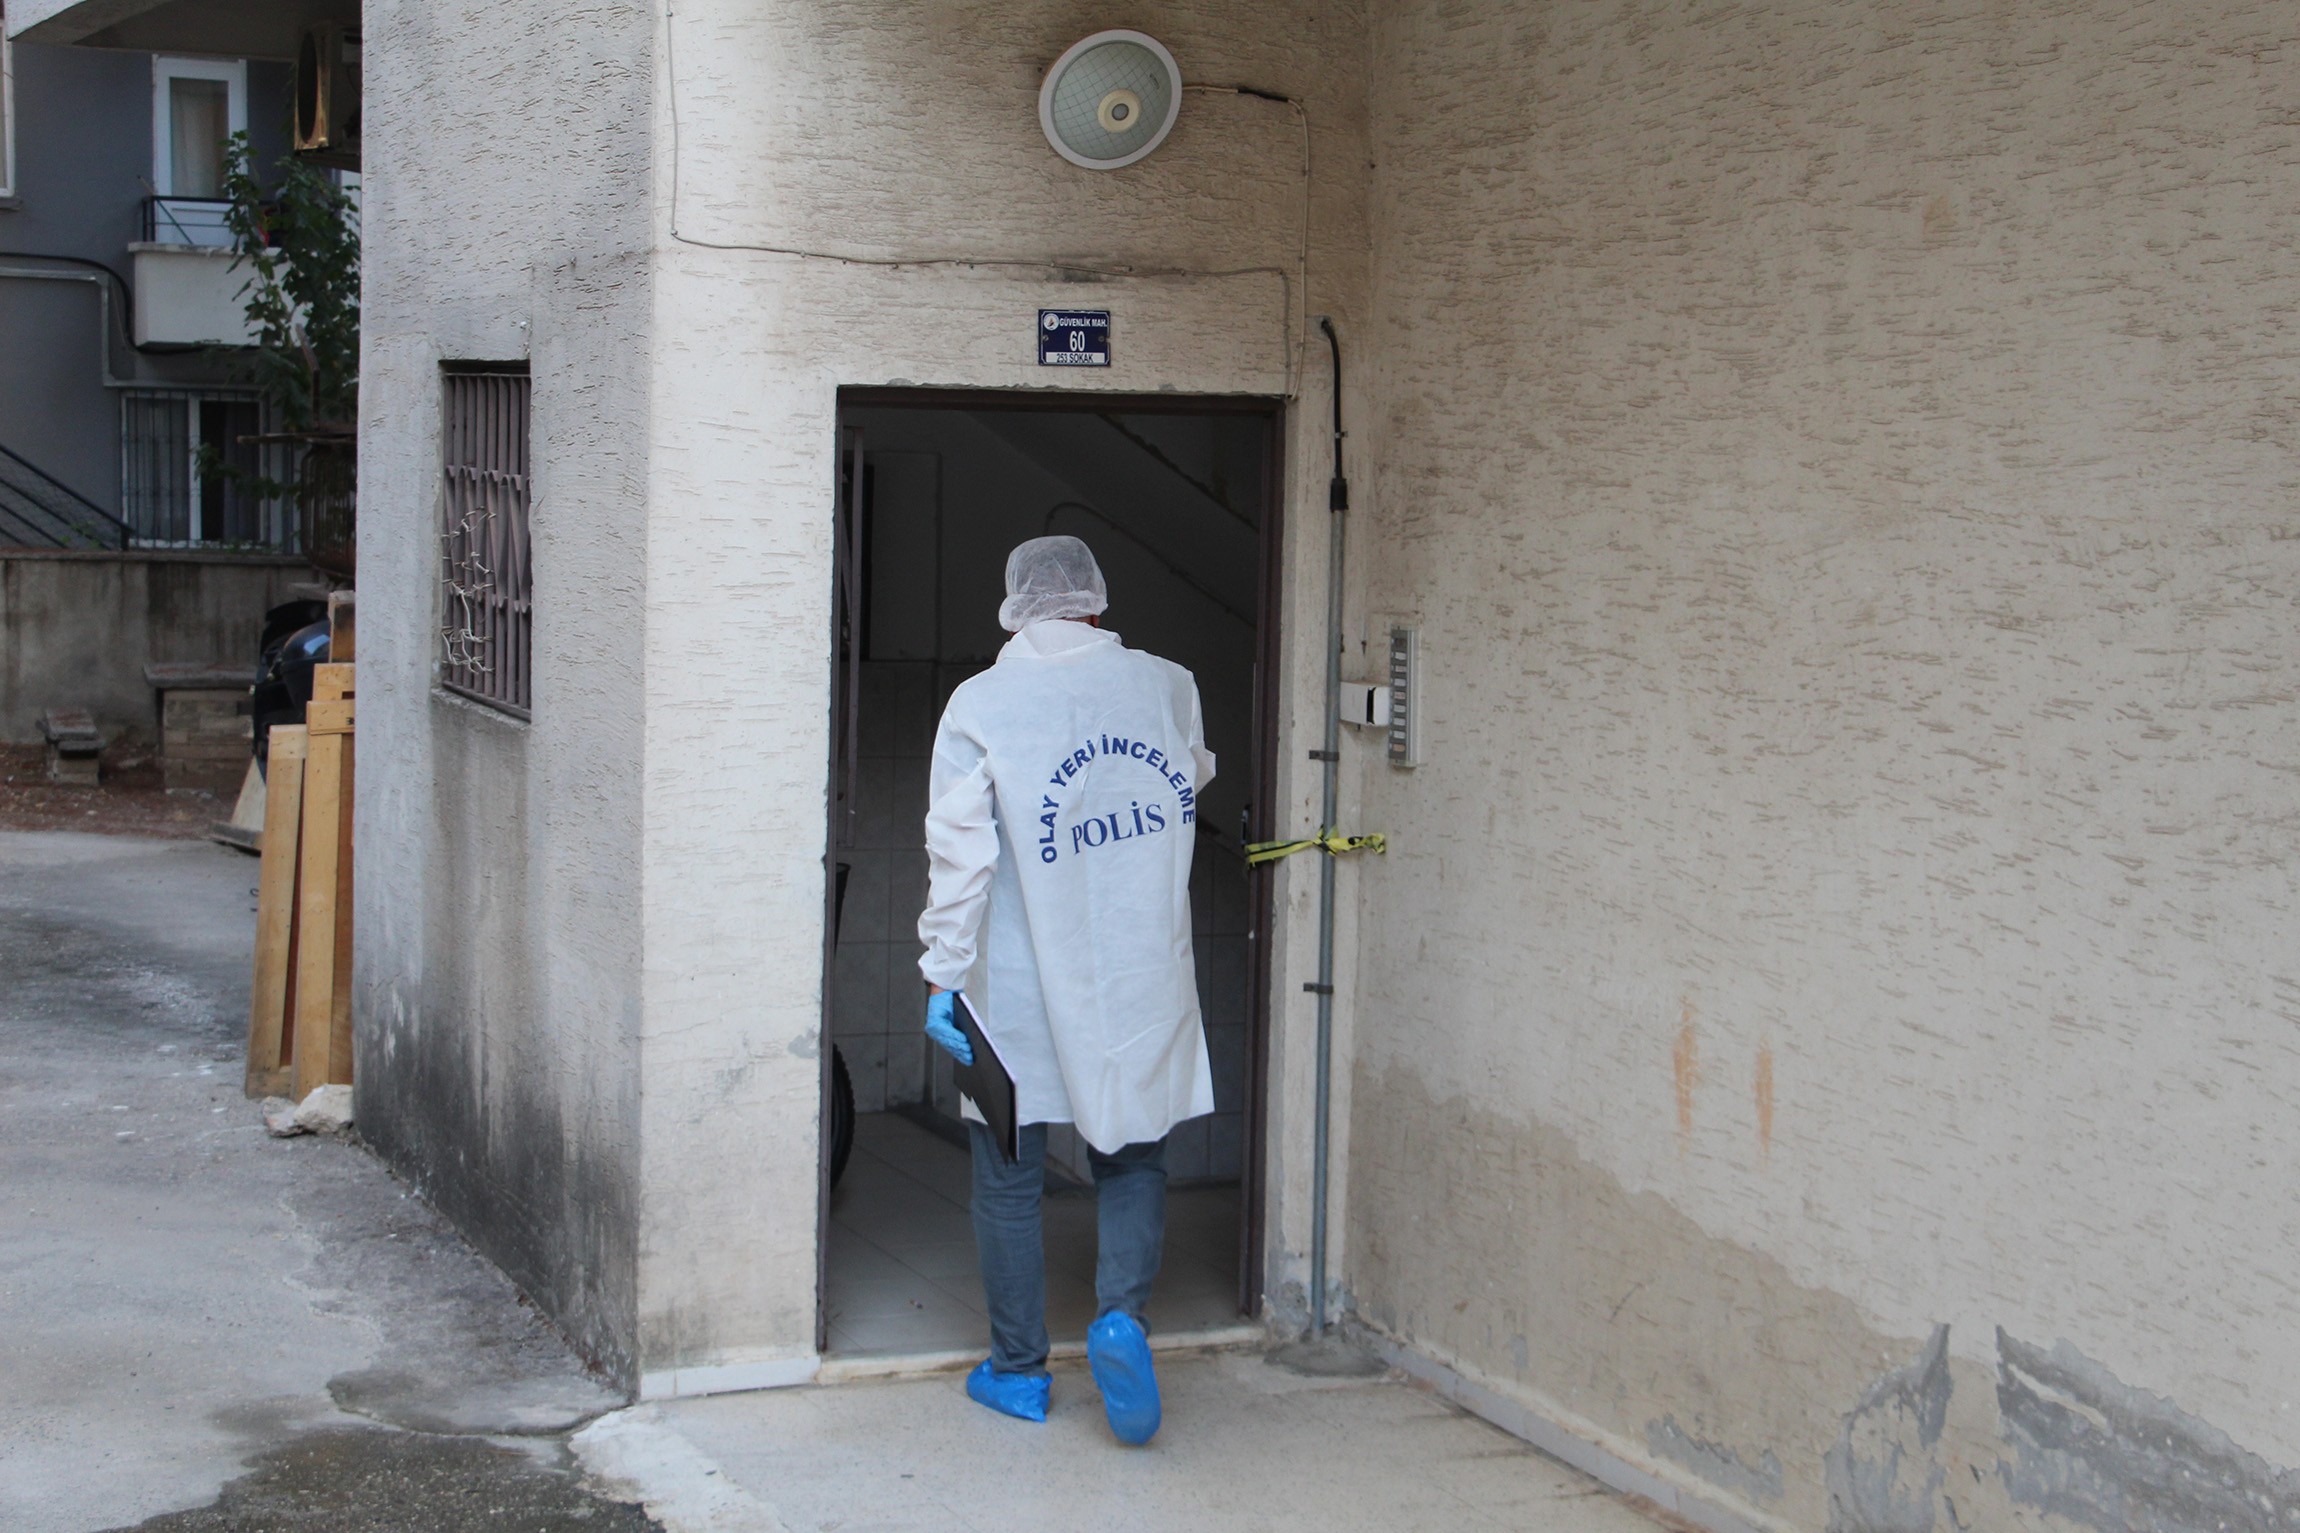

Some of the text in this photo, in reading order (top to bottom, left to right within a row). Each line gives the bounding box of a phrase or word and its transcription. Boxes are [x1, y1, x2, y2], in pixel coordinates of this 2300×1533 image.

[1060, 317, 1091, 327] GÜVENLİK
[1069, 331, 1085, 352] 60
[1069, 353, 1093, 363] SOKAK
[1039, 734, 1195, 863] OLAY YERİ İNCELEME
[1071, 801, 1166, 855] POLİS
